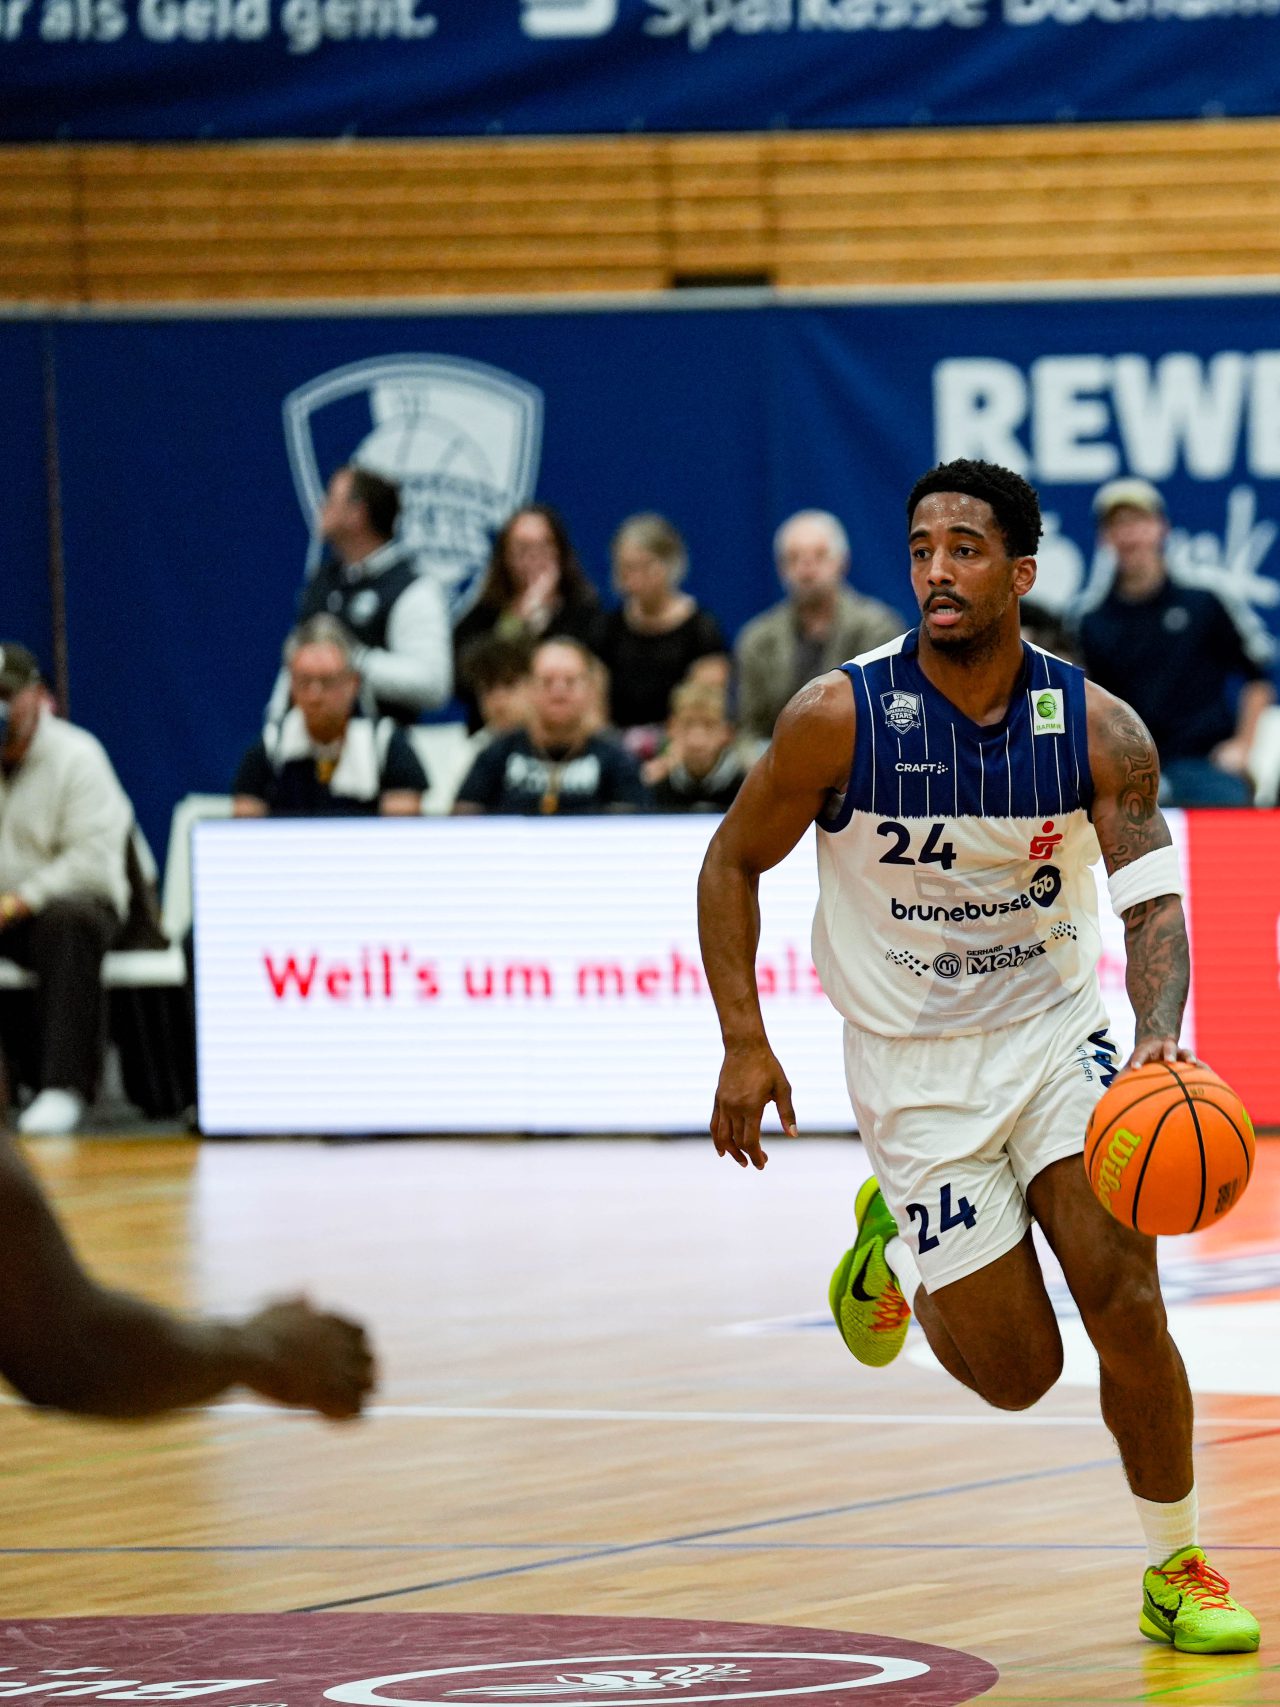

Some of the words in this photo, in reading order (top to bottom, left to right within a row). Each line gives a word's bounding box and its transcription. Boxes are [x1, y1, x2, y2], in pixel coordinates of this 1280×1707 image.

[890, 712, 914, 720] STARS
[895, 763, 936, 773] CRAFT
[876, 821, 957, 871] 24
[891, 893, 1032, 922] brunebusse
[966, 945, 1004, 956] GERHARD
[262, 945, 440, 1000] Weil's
[463, 964, 553, 1000] um
[576, 946, 702, 998] meh
[906, 1183, 977, 1255] 24
